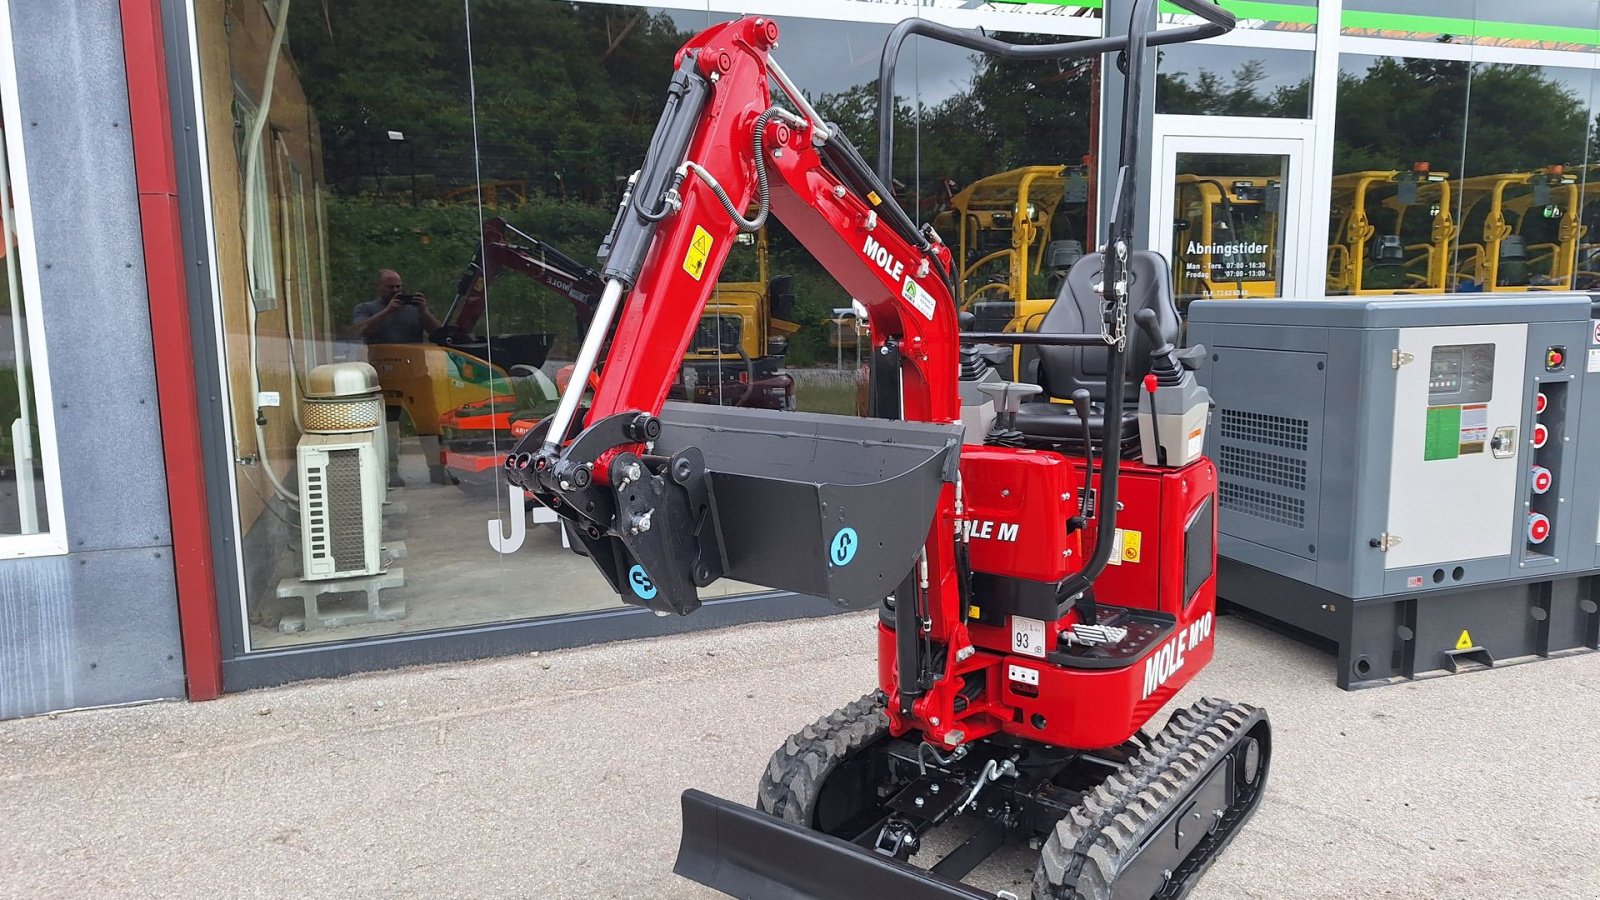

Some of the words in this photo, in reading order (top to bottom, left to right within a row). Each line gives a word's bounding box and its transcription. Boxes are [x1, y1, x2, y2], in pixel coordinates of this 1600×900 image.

[1186, 240, 1268, 256] Åbningstider
[862, 235, 905, 282] MOLE
[1185, 271, 1209, 279] Fredag
[997, 522, 1020, 542] M
[1016, 632, 1029, 649] 93
[1142, 628, 1188, 700] MOLE
[1188, 610, 1212, 651] M10
